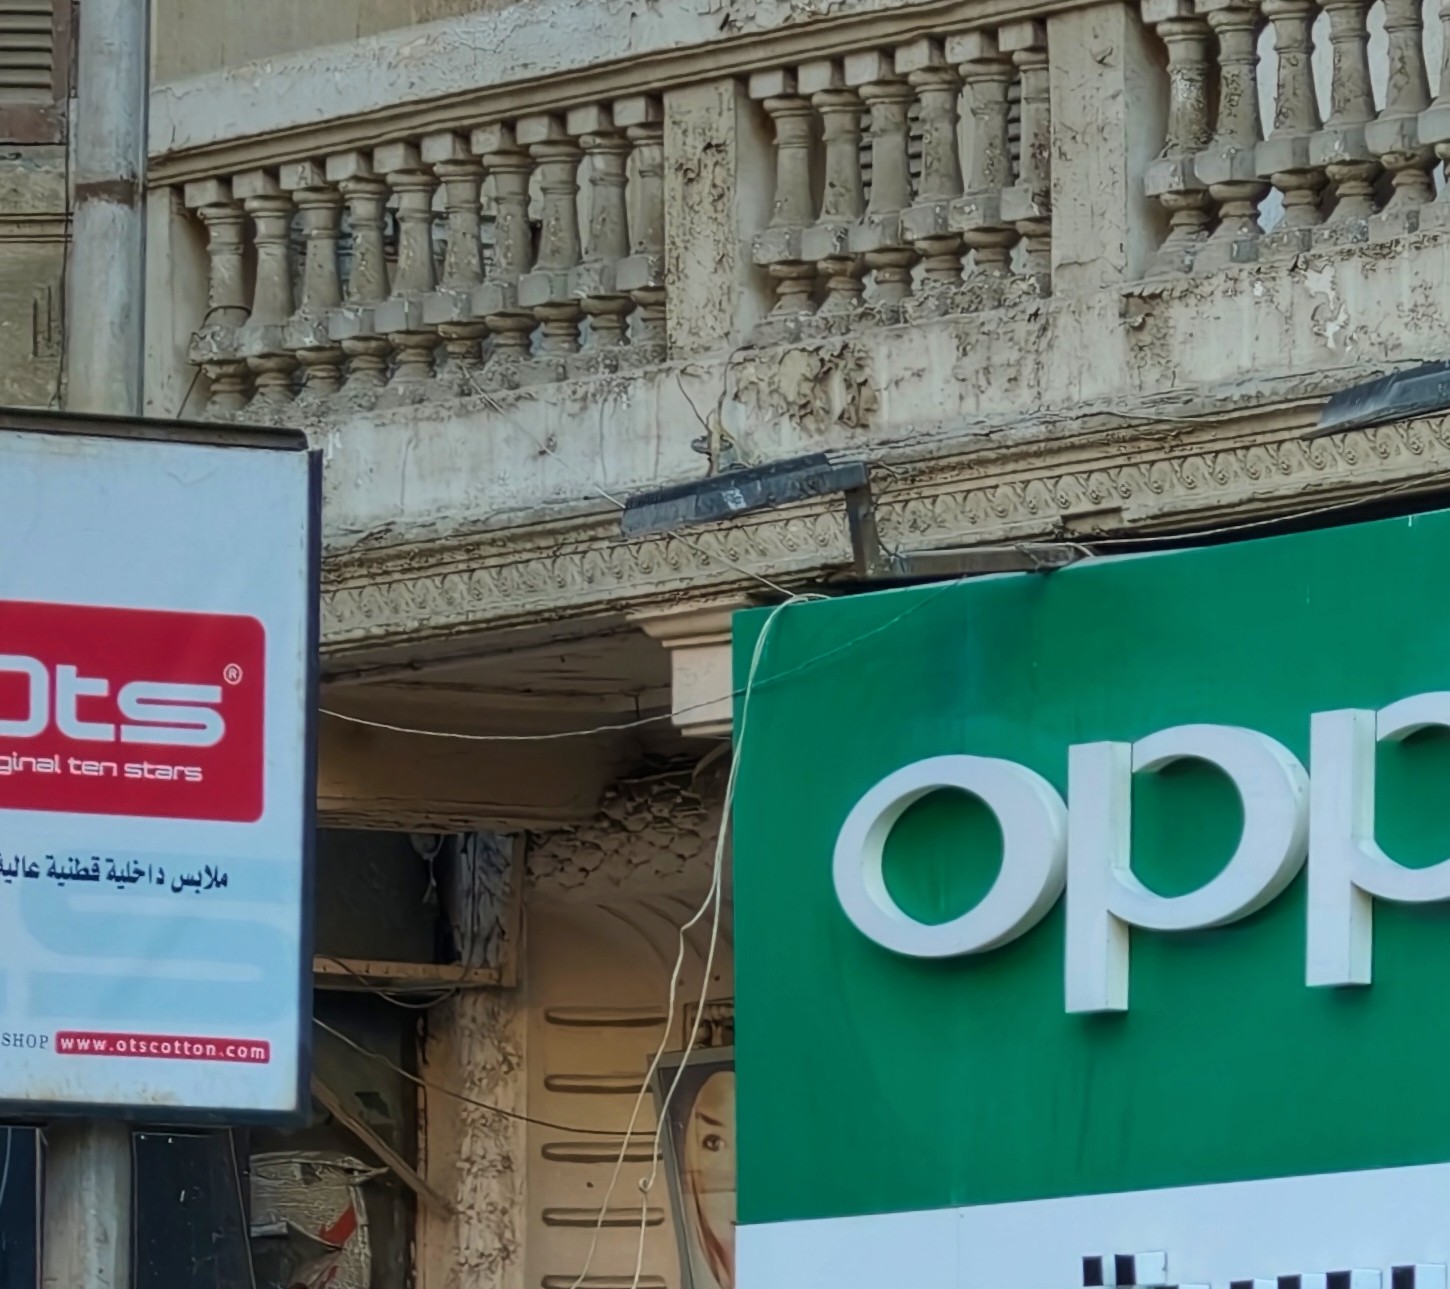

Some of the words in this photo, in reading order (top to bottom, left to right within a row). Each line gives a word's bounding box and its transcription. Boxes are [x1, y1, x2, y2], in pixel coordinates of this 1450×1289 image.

[67, 756, 118, 777] ten
[124, 760, 204, 782] stars
[45, 854, 100, 887] قطنية
[105, 857, 165, 890] داخلية
[171, 863, 228, 894] ملابس
[1, 1032, 49, 1050] SHOP
[60, 1036, 266, 1061] www.otscotton.com
